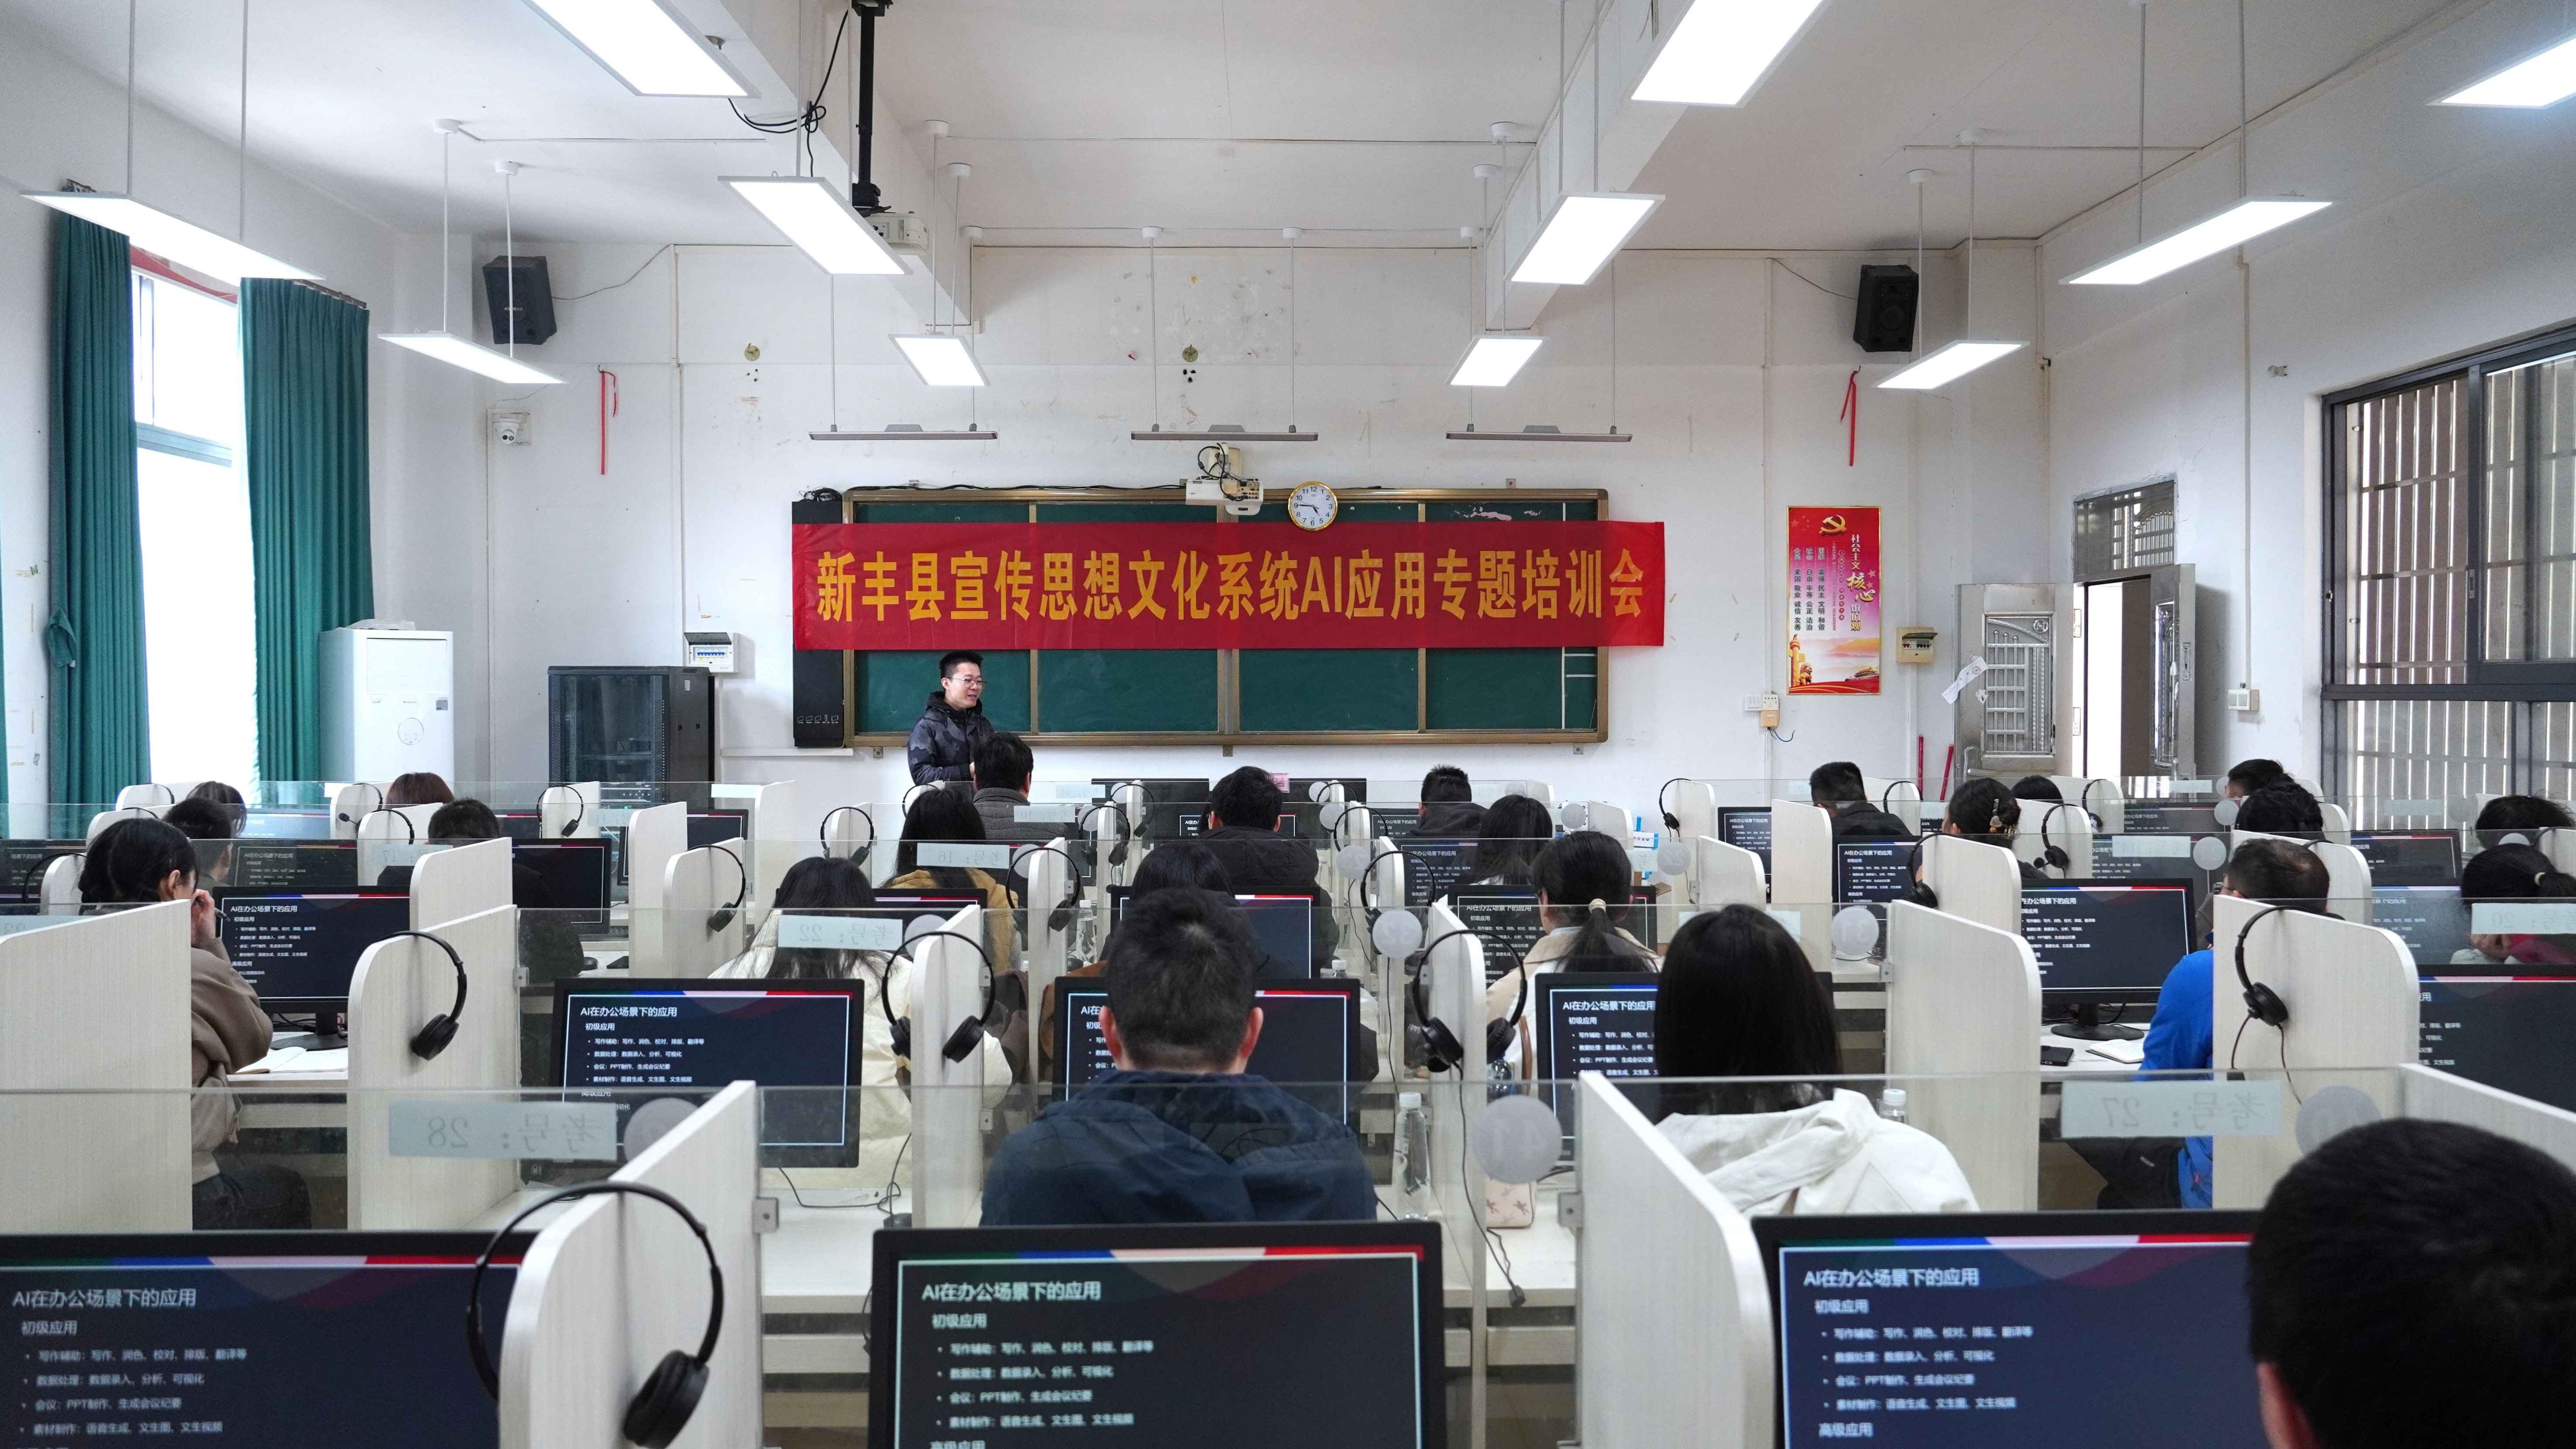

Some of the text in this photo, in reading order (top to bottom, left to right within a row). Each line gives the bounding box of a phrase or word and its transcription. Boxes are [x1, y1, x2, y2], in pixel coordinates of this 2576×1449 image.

[816, 548, 1643, 622] 新丰县宣传思想文化系统AI应用专题培训会
[581, 1007, 677, 1017] AI在办公场景下的应用
[1562, 1000, 1656, 1011] AI在办公场景下的应用
[1086, 1020, 1103, 1029] 初级
[1804, 1268, 1980, 1287] AI在办公场景下的应用
[13, 1289, 196, 1307] AI在办公场景下的应用
[922, 1281, 1101, 1301] AI在办公场景下的应用
[1815, 1299, 1869, 1314] 初级应用
[21, 1320, 77, 1335] 初级应用
[932, 1313, 987, 1328] 初级应用
[1819, 1423, 1873, 1437] 高级应用
